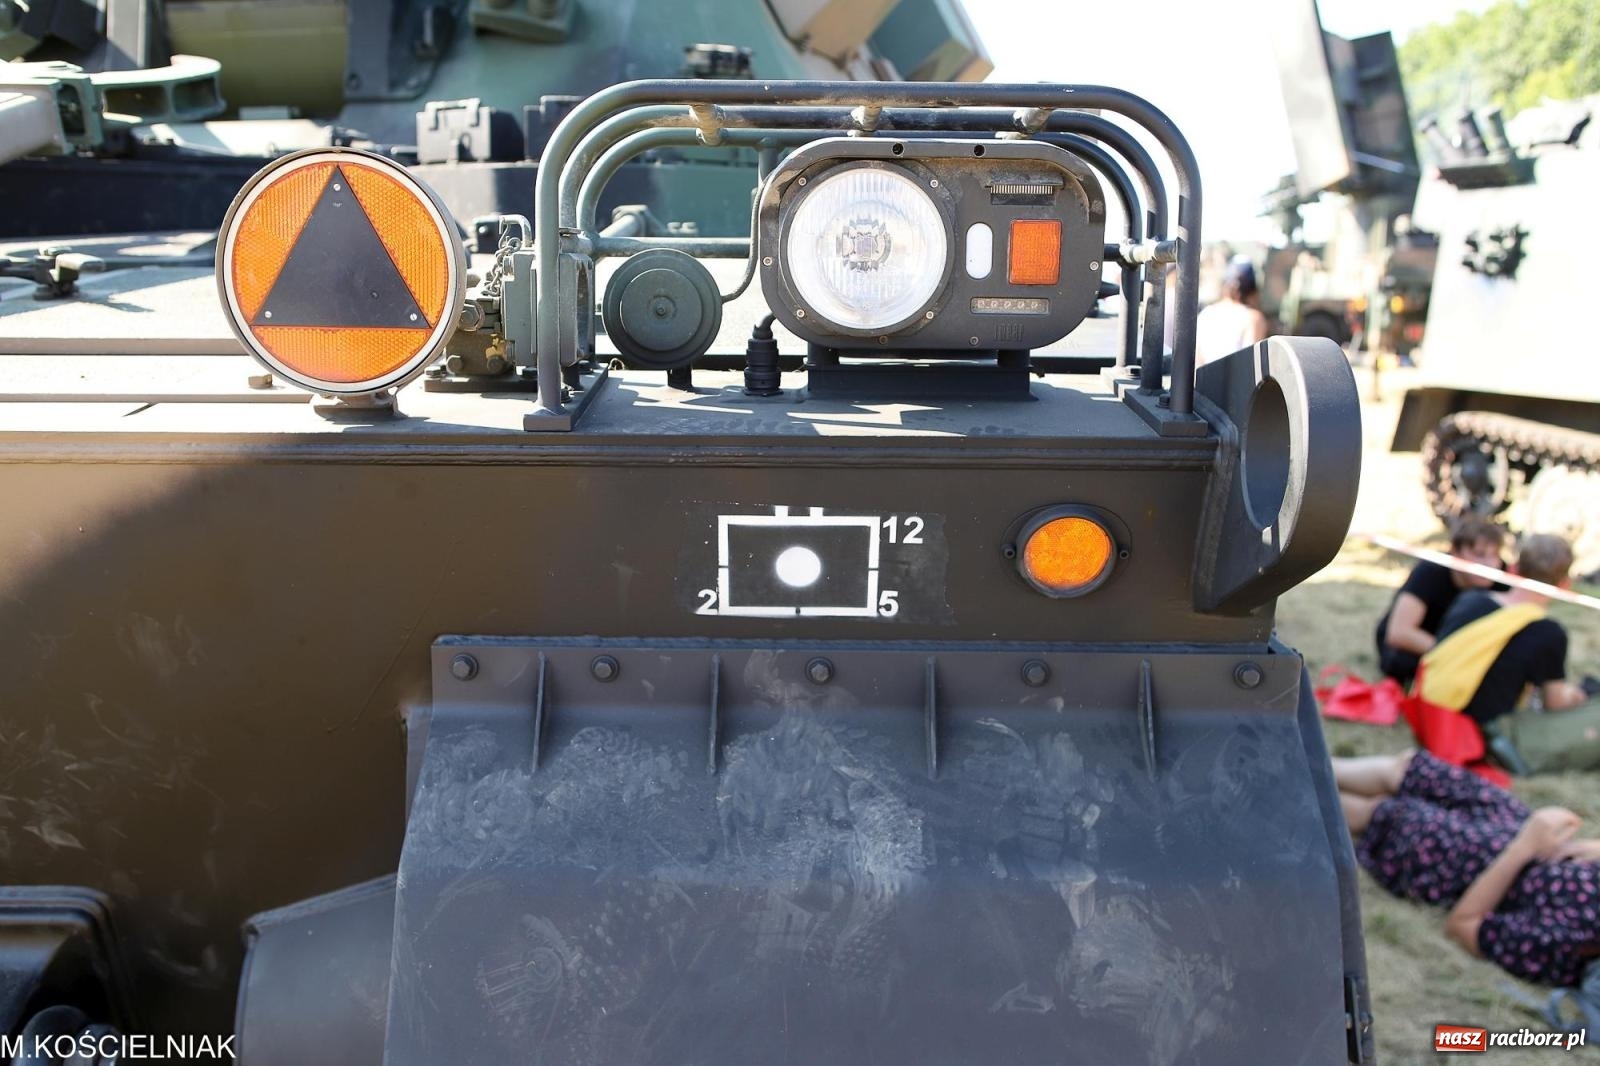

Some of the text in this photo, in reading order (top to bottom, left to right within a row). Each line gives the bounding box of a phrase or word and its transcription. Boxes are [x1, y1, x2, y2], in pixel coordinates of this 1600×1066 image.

[882, 515, 925, 544] 12
[695, 588, 719, 615] 2
[878, 590, 899, 618] 5
